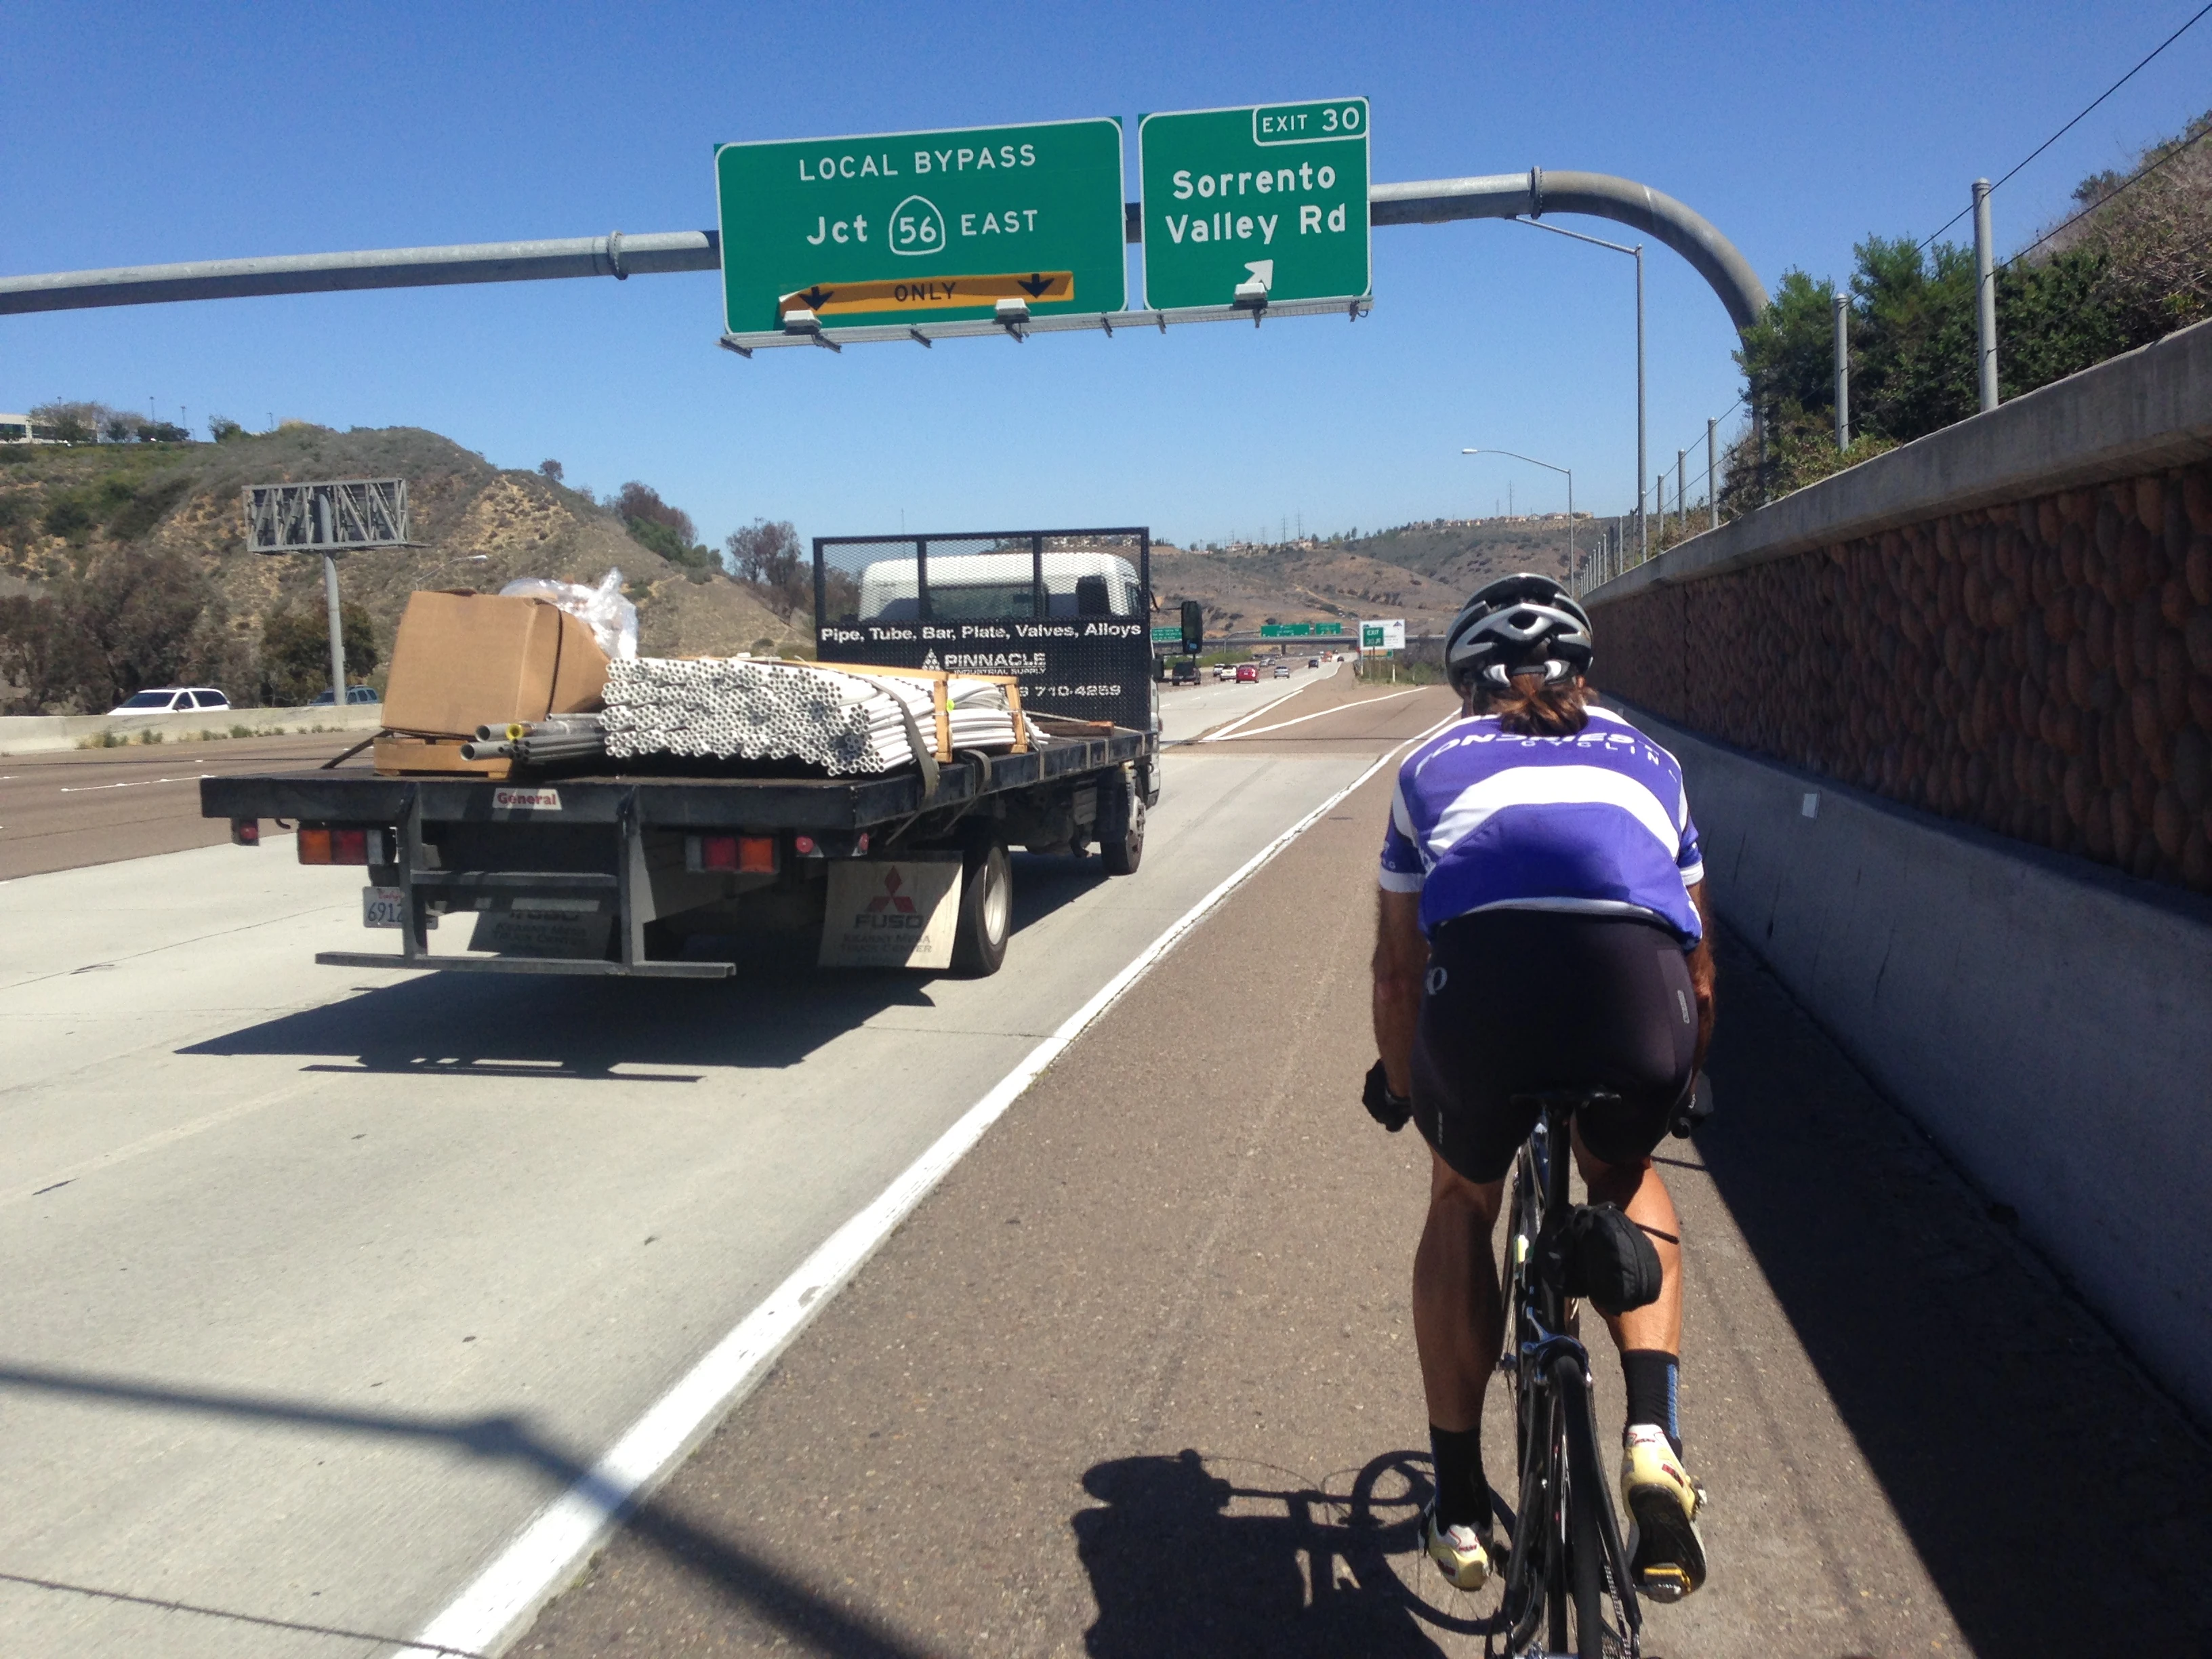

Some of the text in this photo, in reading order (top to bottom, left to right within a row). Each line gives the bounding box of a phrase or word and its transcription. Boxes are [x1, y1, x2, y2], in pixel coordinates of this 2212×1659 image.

[1263, 106, 1359, 133] EXIT 30
[799, 144, 1036, 181] LOCAL BYPASS
[1172, 161, 1336, 199] Sorrento
[806, 209, 1038, 245] Jct 56 EAST
[1165, 203, 1345, 245] Valley Rd
[894, 282, 956, 302] ONLY
[821, 622, 1142, 644] Pipe, Tube, Bar, Plate, Valves, Alloys
[944, 652, 1046, 667] PINNACLE
[497, 792, 556, 806] General
[853, 914, 924, 929] FUSO
